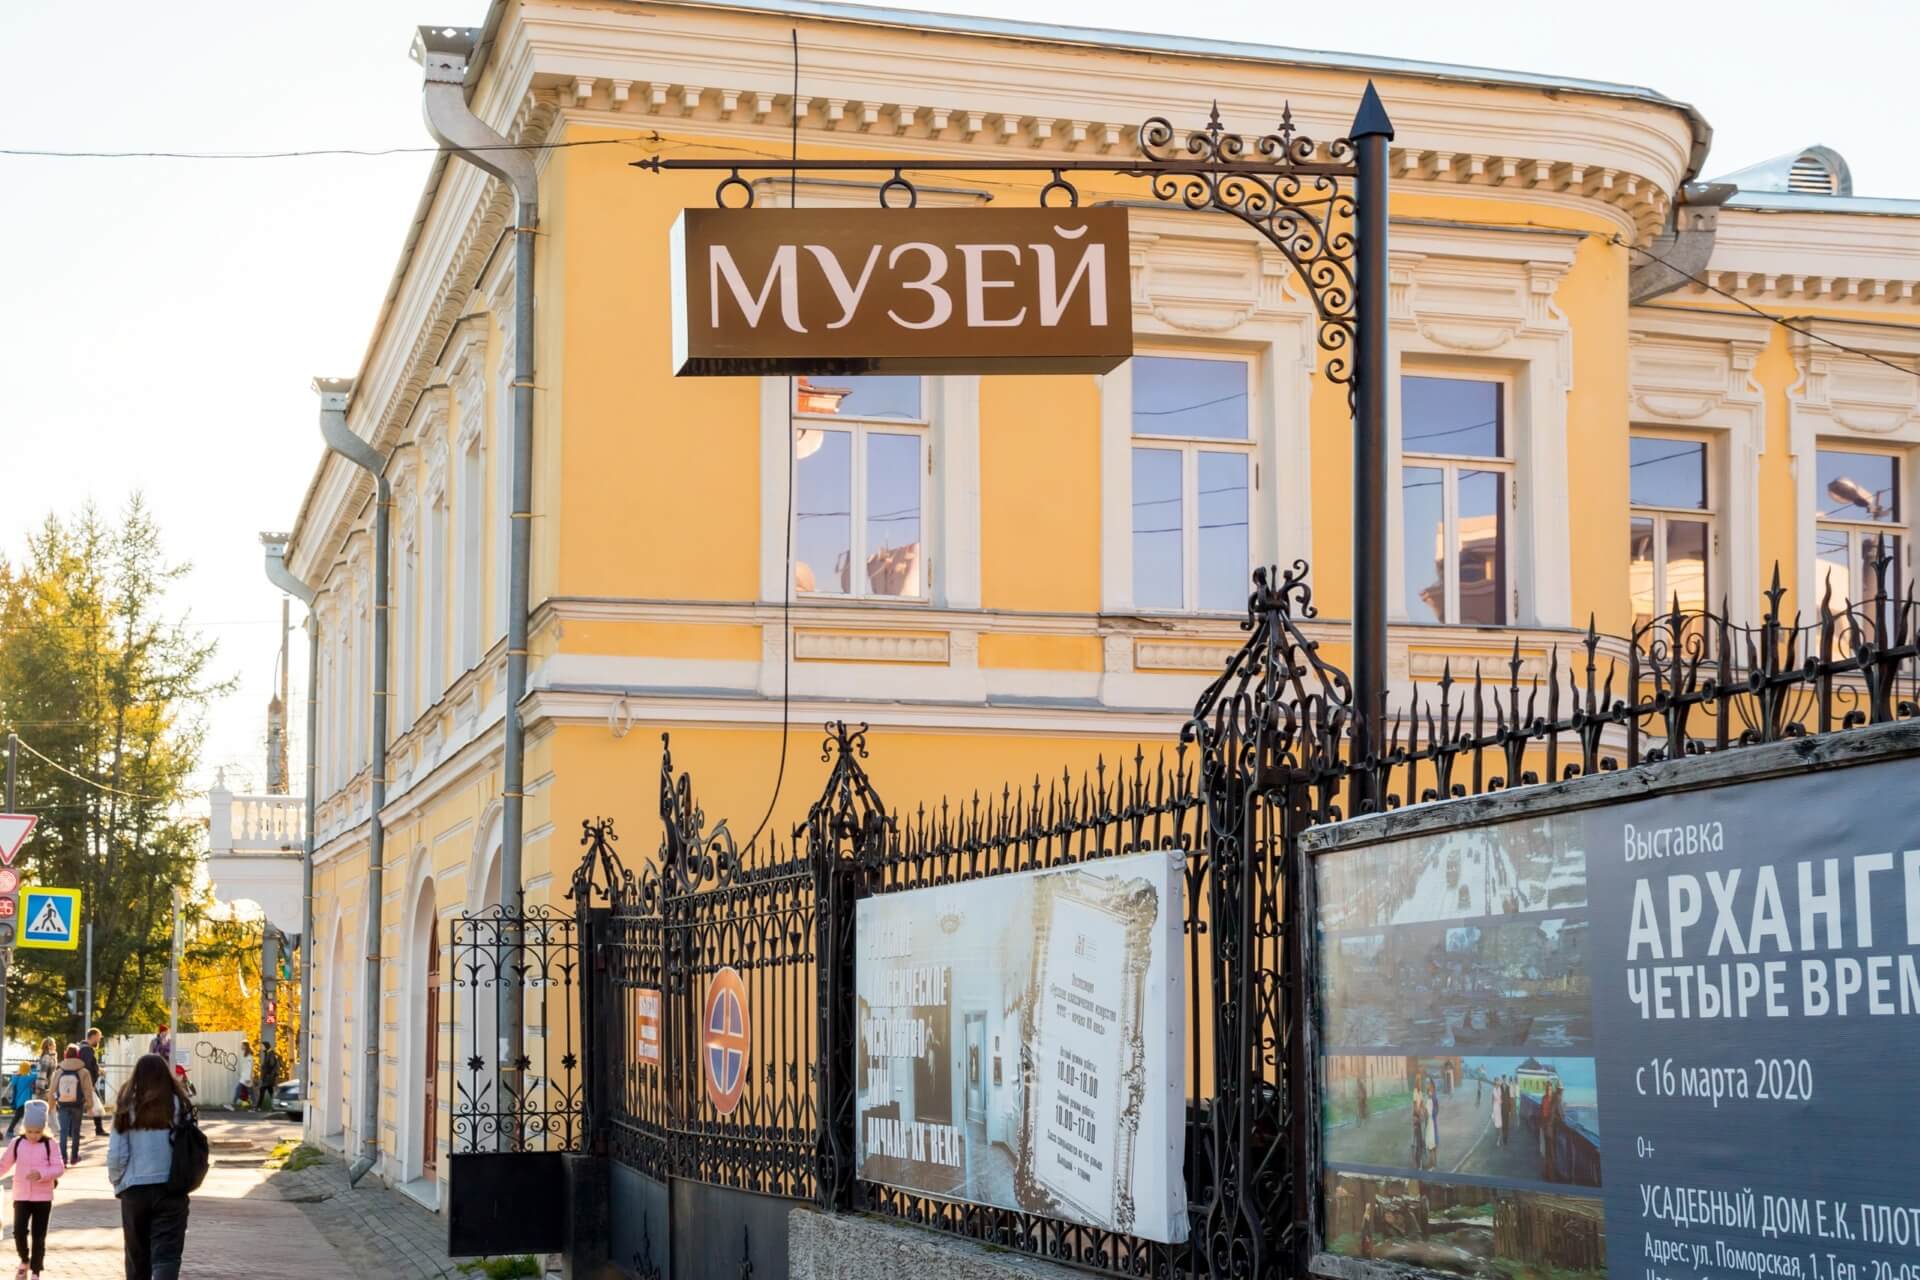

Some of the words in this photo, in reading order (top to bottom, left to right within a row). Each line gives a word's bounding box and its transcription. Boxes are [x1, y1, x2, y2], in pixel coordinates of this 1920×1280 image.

[709, 224, 1108, 333] МУЗЕЙ
[1624, 821, 1724, 862] Выставка
[1627, 960, 1789, 1019] ЧЕТЫРЕ
[1636, 1066, 1647, 1095] с
[1650, 1058, 1675, 1096] 16
[1681, 1067, 1749, 1108] марта
[1754, 1059, 1813, 1101] 2020
[929, 1123, 961, 1168] ВЕКА
[1637, 1136, 1655, 1158] 0+
[1640, 1183, 1756, 1229] УСАДЕБНЫЙ
[1762, 1195, 1811, 1239] ДОМ
[1816, 1199, 1856, 1240] Е.К.
[1861, 1204, 1920, 1247] ПЛОТ
[1645, 1231, 1689, 1267] Адрес:
[1691, 1244, 1713, 1271] ул.
[1715, 1239, 1806, 1280] Поморская,
